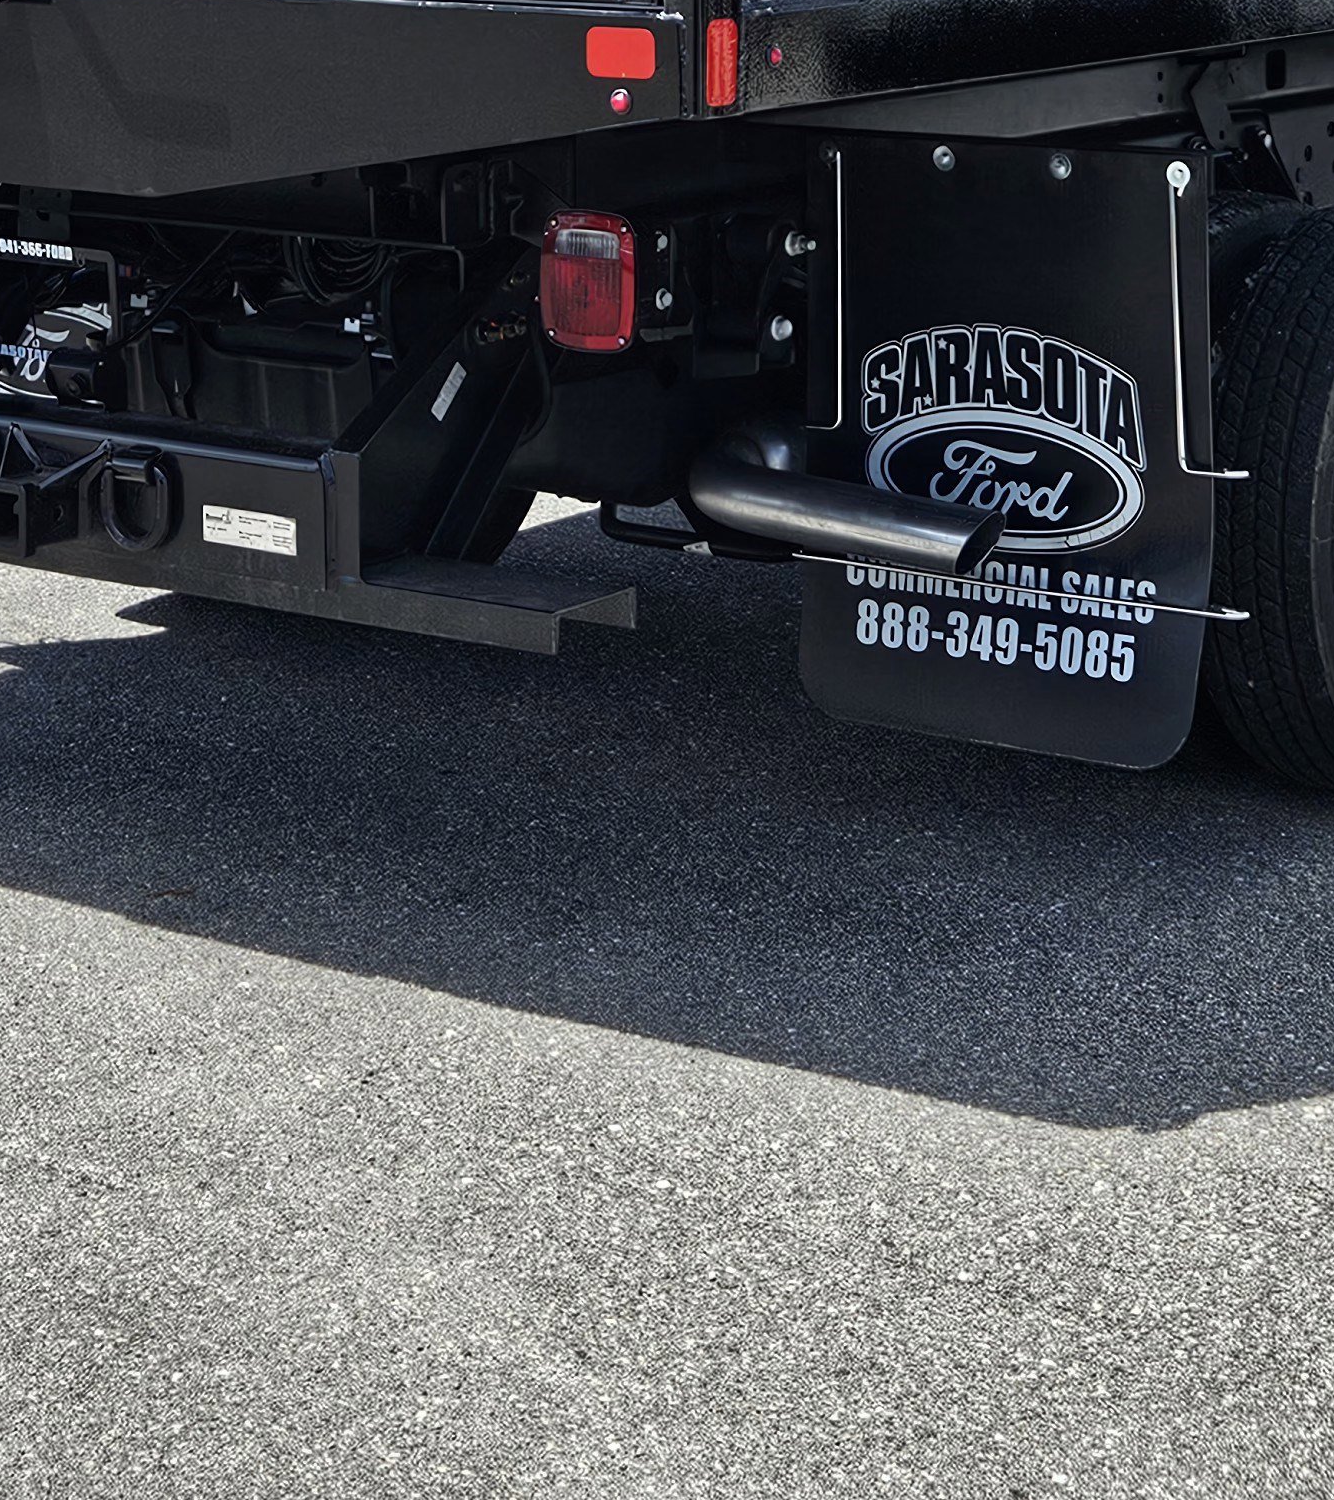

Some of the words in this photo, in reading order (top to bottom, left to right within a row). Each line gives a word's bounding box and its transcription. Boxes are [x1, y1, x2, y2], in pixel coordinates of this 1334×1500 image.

[861, 323, 1147, 472] SARASOTA
[929, 439, 1074, 522] Ford
[1061, 570, 1157, 624] SALES
[856, 598, 1136, 683] 888-349-5085
